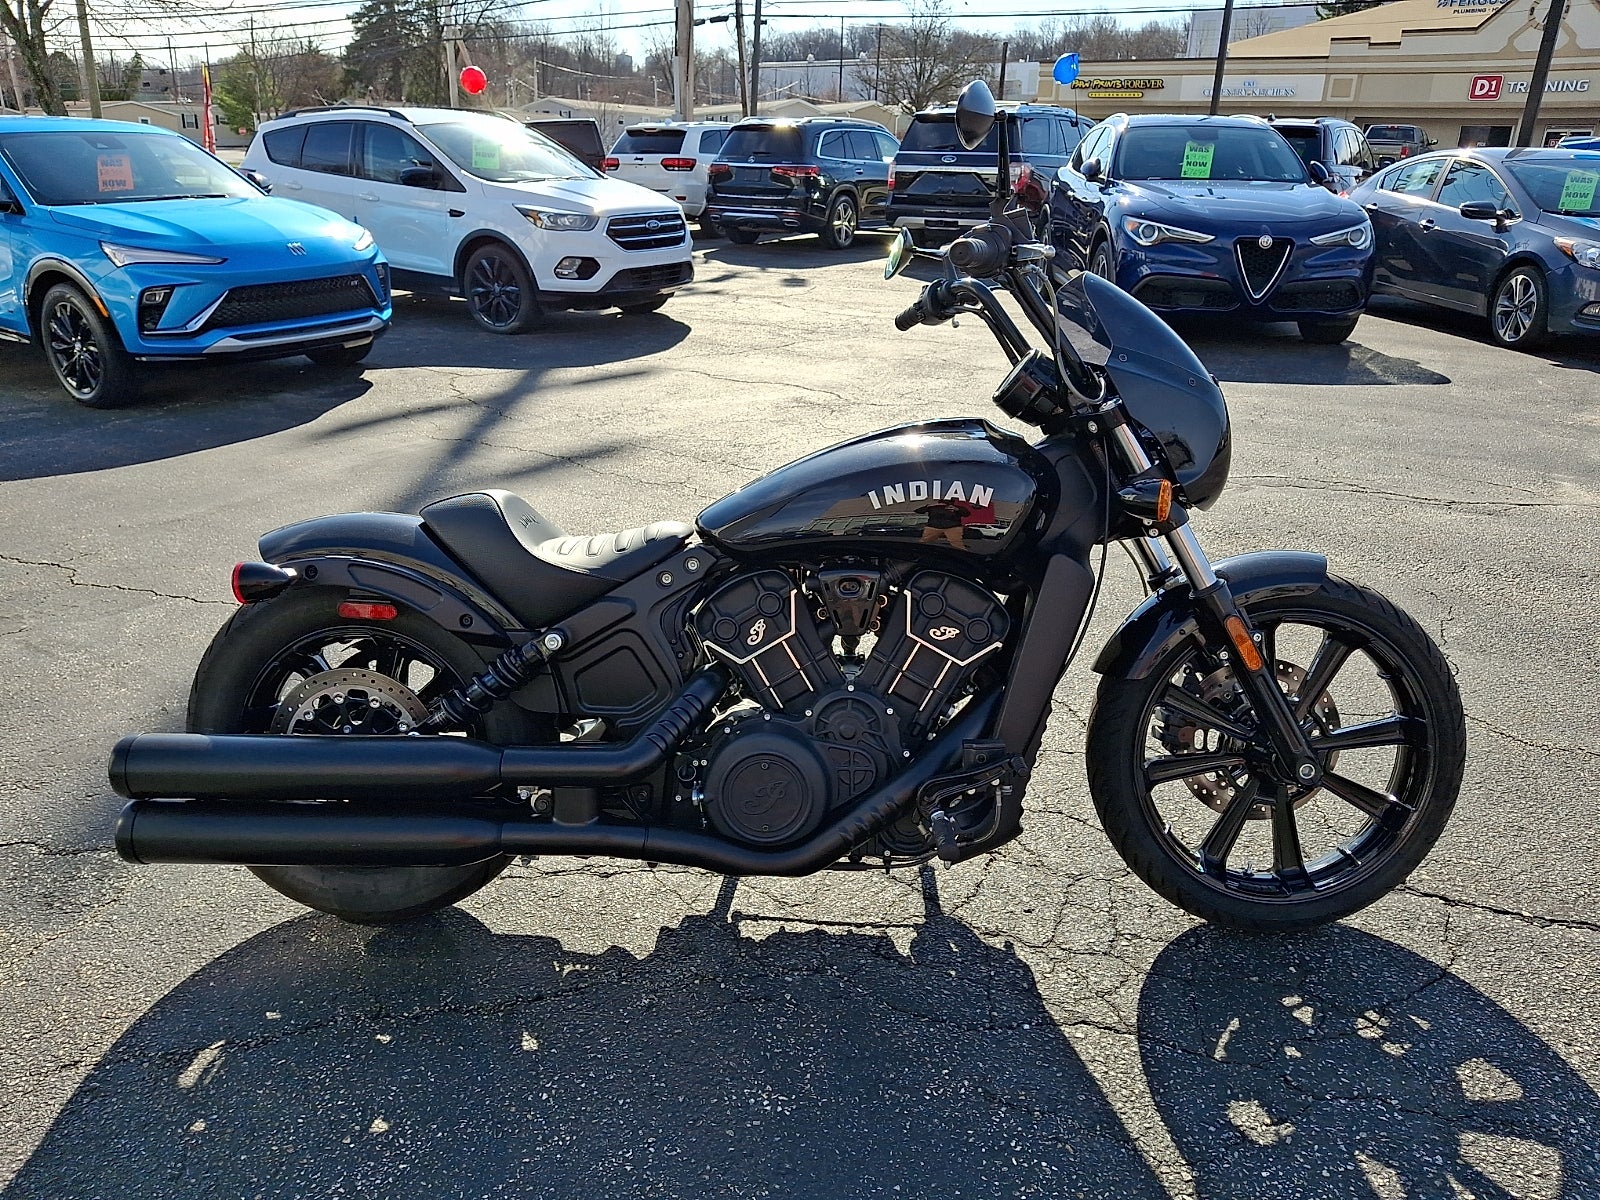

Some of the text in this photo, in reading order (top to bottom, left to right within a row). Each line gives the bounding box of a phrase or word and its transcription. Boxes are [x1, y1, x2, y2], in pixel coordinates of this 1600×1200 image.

[1092, 79, 1122, 89] PRINTS
[1124, 79, 1164, 89] FOREVER
[1474, 79, 1590, 96] D1 TRNING
[1189, 145, 1210, 153] WAS
[101, 159, 123, 167] WAS
[102, 179, 127, 187] NOW
[1570, 176, 1593, 184] WAS
[867, 480, 994, 510] INDIAN
